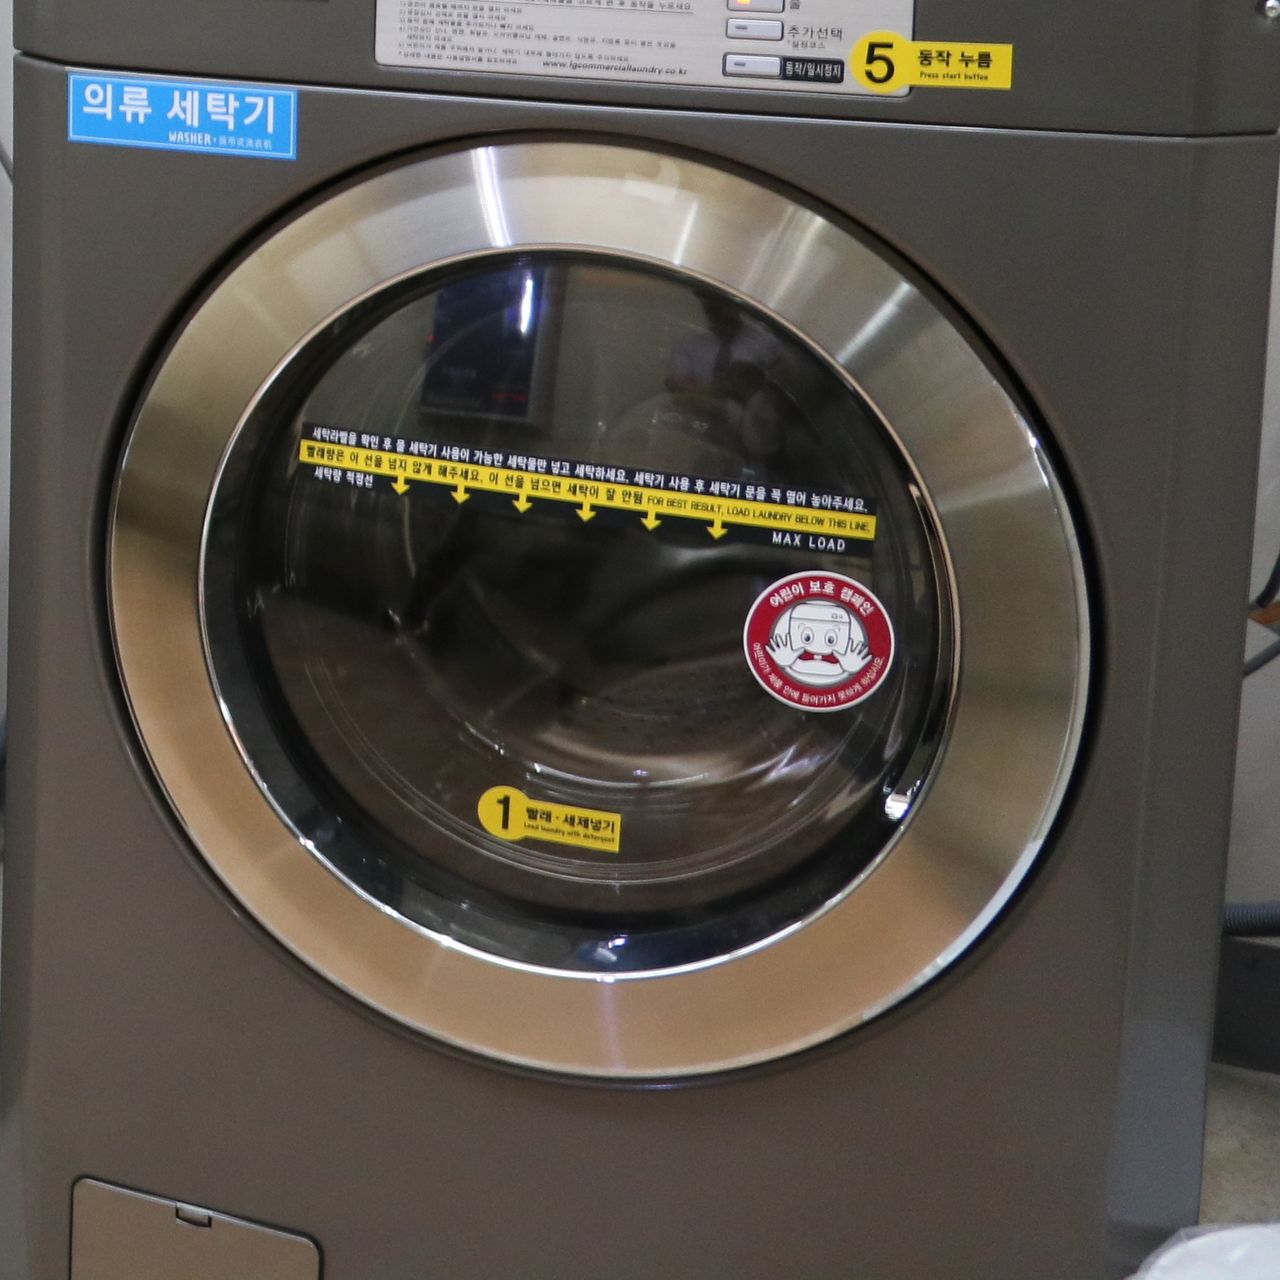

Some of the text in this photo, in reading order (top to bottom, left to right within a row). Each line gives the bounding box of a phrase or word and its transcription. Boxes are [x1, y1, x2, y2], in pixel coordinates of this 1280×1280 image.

[787, 27, 843, 40] 추가선택
[865, 42, 992, 83] 5 동작 누름
[920, 71, 989, 81] Press start button
[83, 83, 274, 134] 의류 세탁기
[169, 131, 210, 145] WASHER
[312, 426, 356, 445] 세탁라벨을
[361, 434, 380, 449] 확인
[383, 437, 390, 450] 후
[409, 440, 437, 457] 세탁기
[441, 446, 469, 462] 사용이
[474, 450, 503, 466] 가능한
[508, 454, 547, 472] 세탁물만
[551, 461, 570, 476] 넣고
[635, 472, 664, 488] 세탁기
[669, 477, 689, 491] 사용
[694, 479, 704, 492] 후
[710, 481, 740, 500] 세탁기
[745, 486, 765, 500] 문을
[771, 489, 781, 502] 꼭
[786, 491, 806, 506] 열어
[314, 466, 373, 488] 세탁량 적정선
[306, 445, 344, 461] 빨래량은
[350, 450, 359, 463] 이
[364, 451, 382, 468] 선을
[388, 458, 407, 470] 넘지
[412, 461, 432, 475] 않게
[489, 470, 498, 484] 이
[504, 472, 524, 488] 선을
[530, 477, 561, 494] 넘으면
[567, 481, 600, 500] 세탁이
[606, 488, 616, 500] 잘
[622, 490, 642, 504] 안됨
[648, 496, 664, 506] FOR
[667, 498, 688, 508] BEST
[727, 506, 750, 516] LOAD
[753, 508, 792, 522] LAUNDRY
[796, 513, 824, 526] BELOW
[829, 517, 847, 528] THIS
[772, 531, 845, 552] MAX LOAD
[769, 581, 875, 616] 어린이 보호 캠페인
[497, 796, 614, 833] 1 빨래 세제넣기
